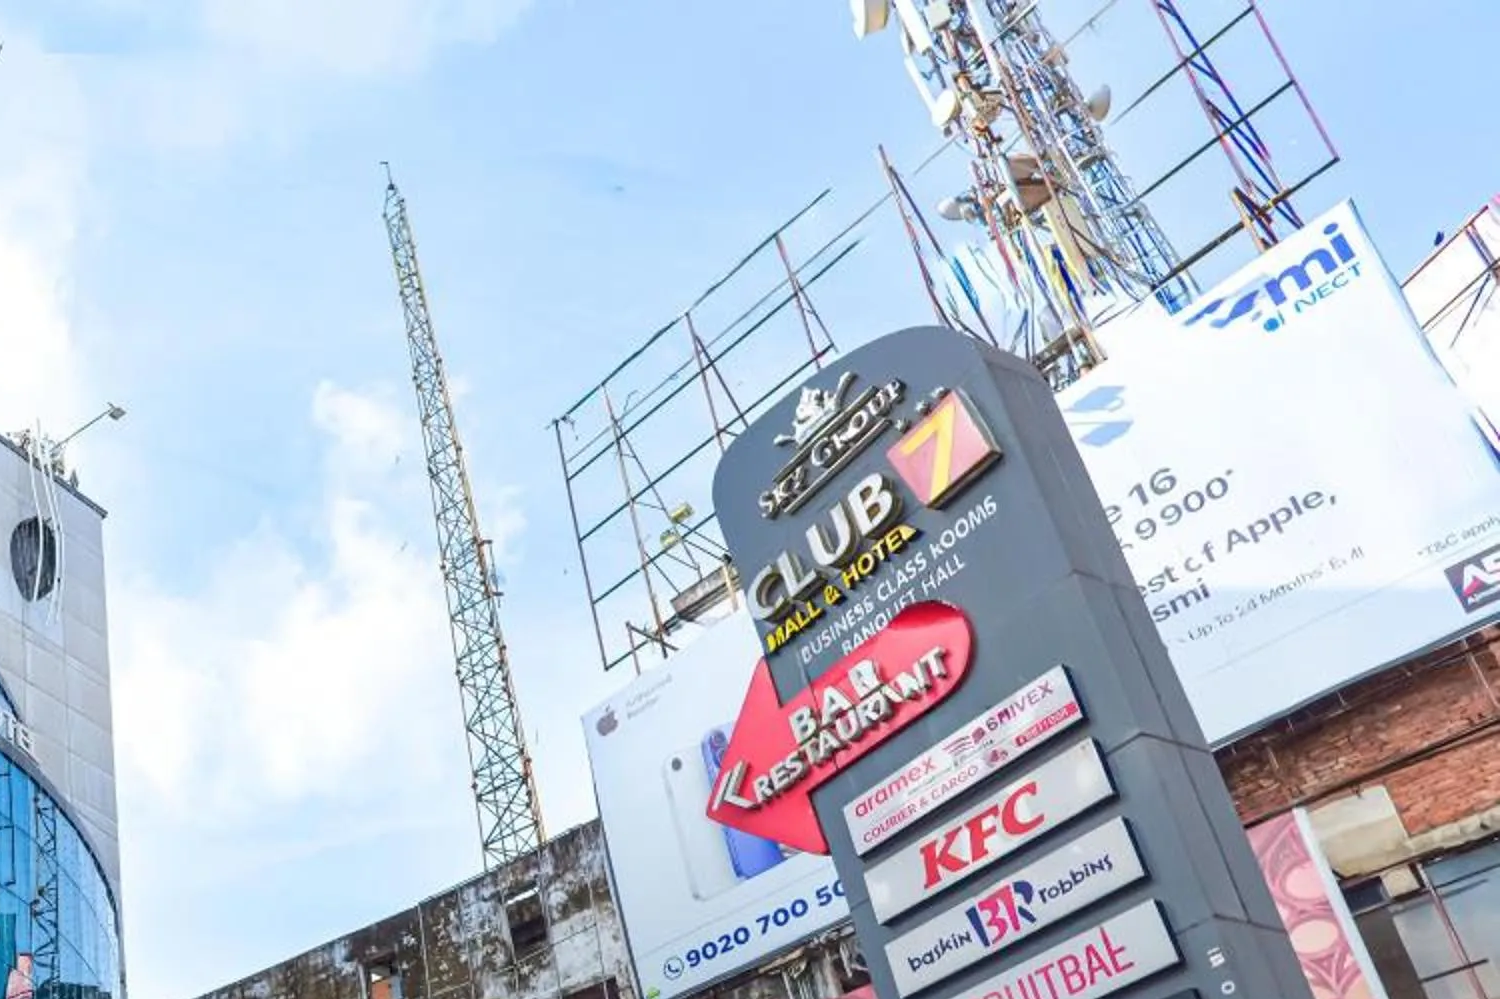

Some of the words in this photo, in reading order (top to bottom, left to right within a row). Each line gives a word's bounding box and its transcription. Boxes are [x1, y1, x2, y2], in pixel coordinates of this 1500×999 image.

[1128, 467, 1178, 505] 16
[1226, 489, 1337, 553] Apple,
[750, 472, 901, 621] CLUB
[765, 601, 823, 652] MALL
[823, 584, 843, 606] &
[841, 523, 918, 588] HOTEL
[921, 554, 966, 595] HALL
[801, 596, 875, 664] BUSINESS
[877, 551, 927, 601] CLASS
[751, 645, 952, 806] RESTAURANT
[790, 657, 883, 744] BAR
[854, 757, 938, 818] aramex
[863, 803, 917, 843] COURIER
[930, 763, 980, 802] CARGO
[919, 781, 1045, 889] KFC
[685, 926, 750, 968] 9020
[756, 900, 809, 936] 700
[906, 928, 974, 974] baskin
[1037, 853, 1114, 905] robbins
